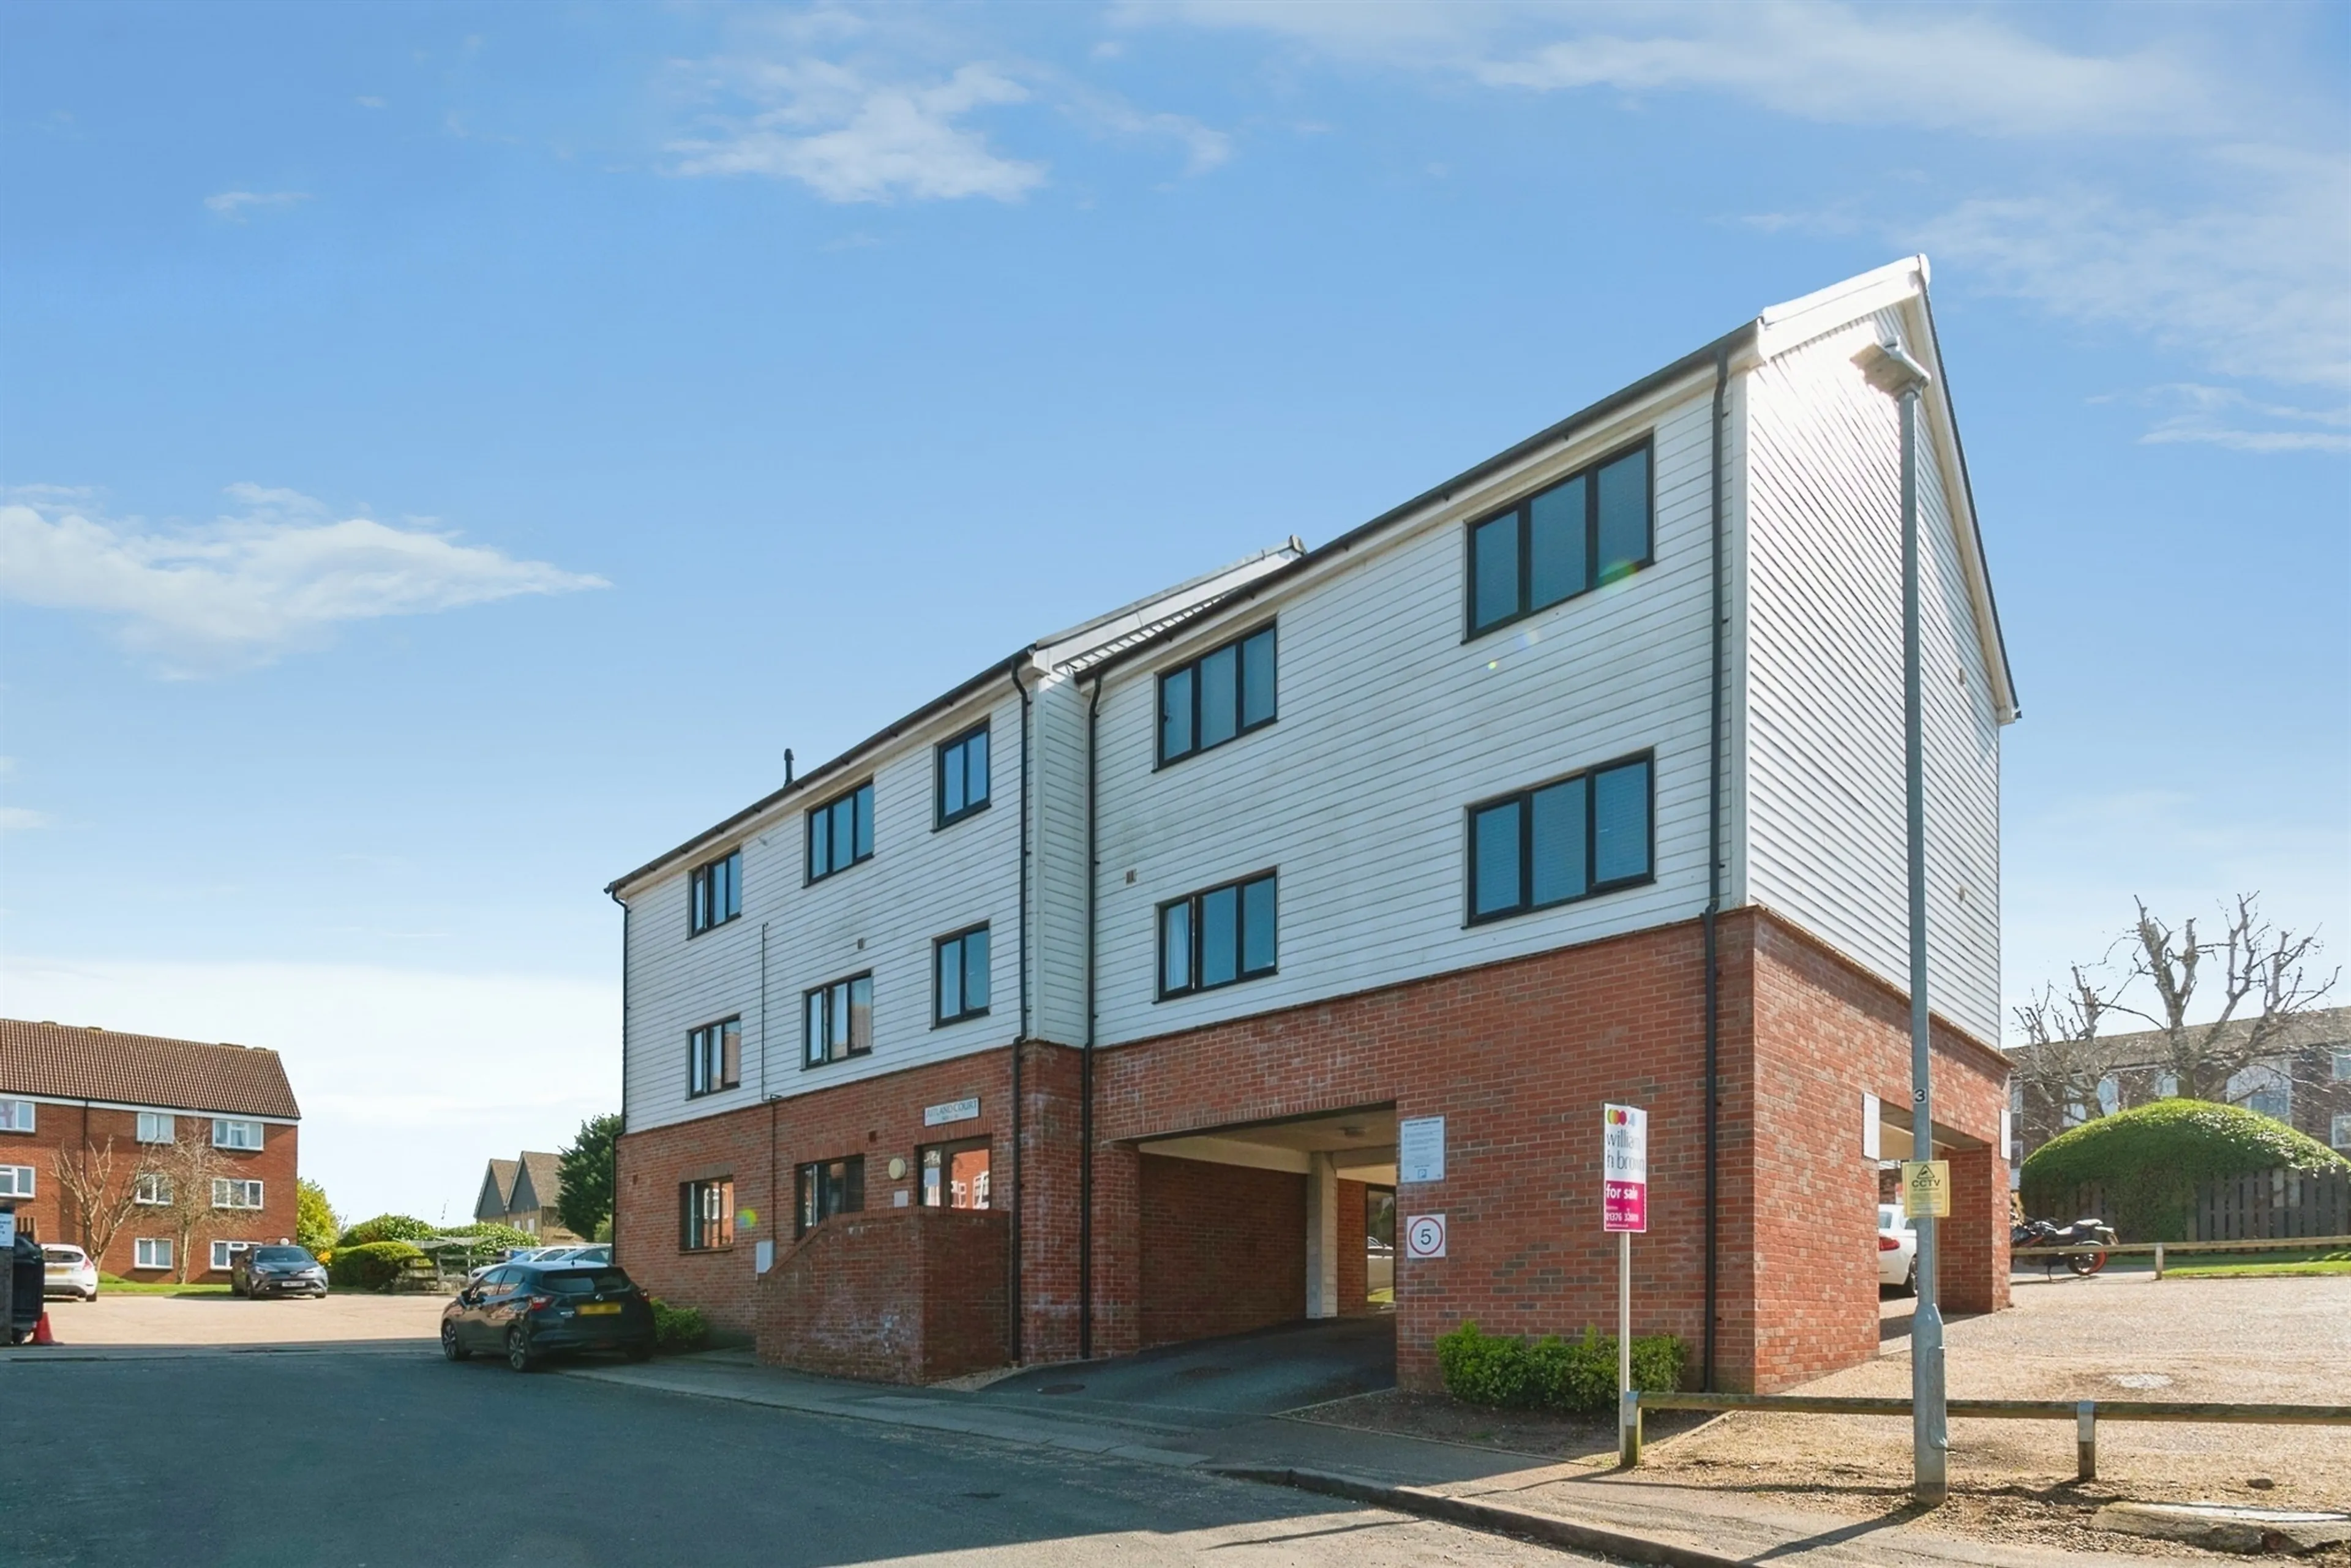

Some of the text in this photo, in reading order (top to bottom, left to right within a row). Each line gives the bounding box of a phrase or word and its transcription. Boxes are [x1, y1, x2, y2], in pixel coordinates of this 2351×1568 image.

[1914, 1089, 1925, 1102] 3
[954, 1100, 977, 1112] COURT
[1607, 1150, 1614, 1168] h
[1911, 1179, 1941, 1188] CCTV
[1605, 1184, 1621, 1199] for
[1420, 1229, 1431, 1245] 5
